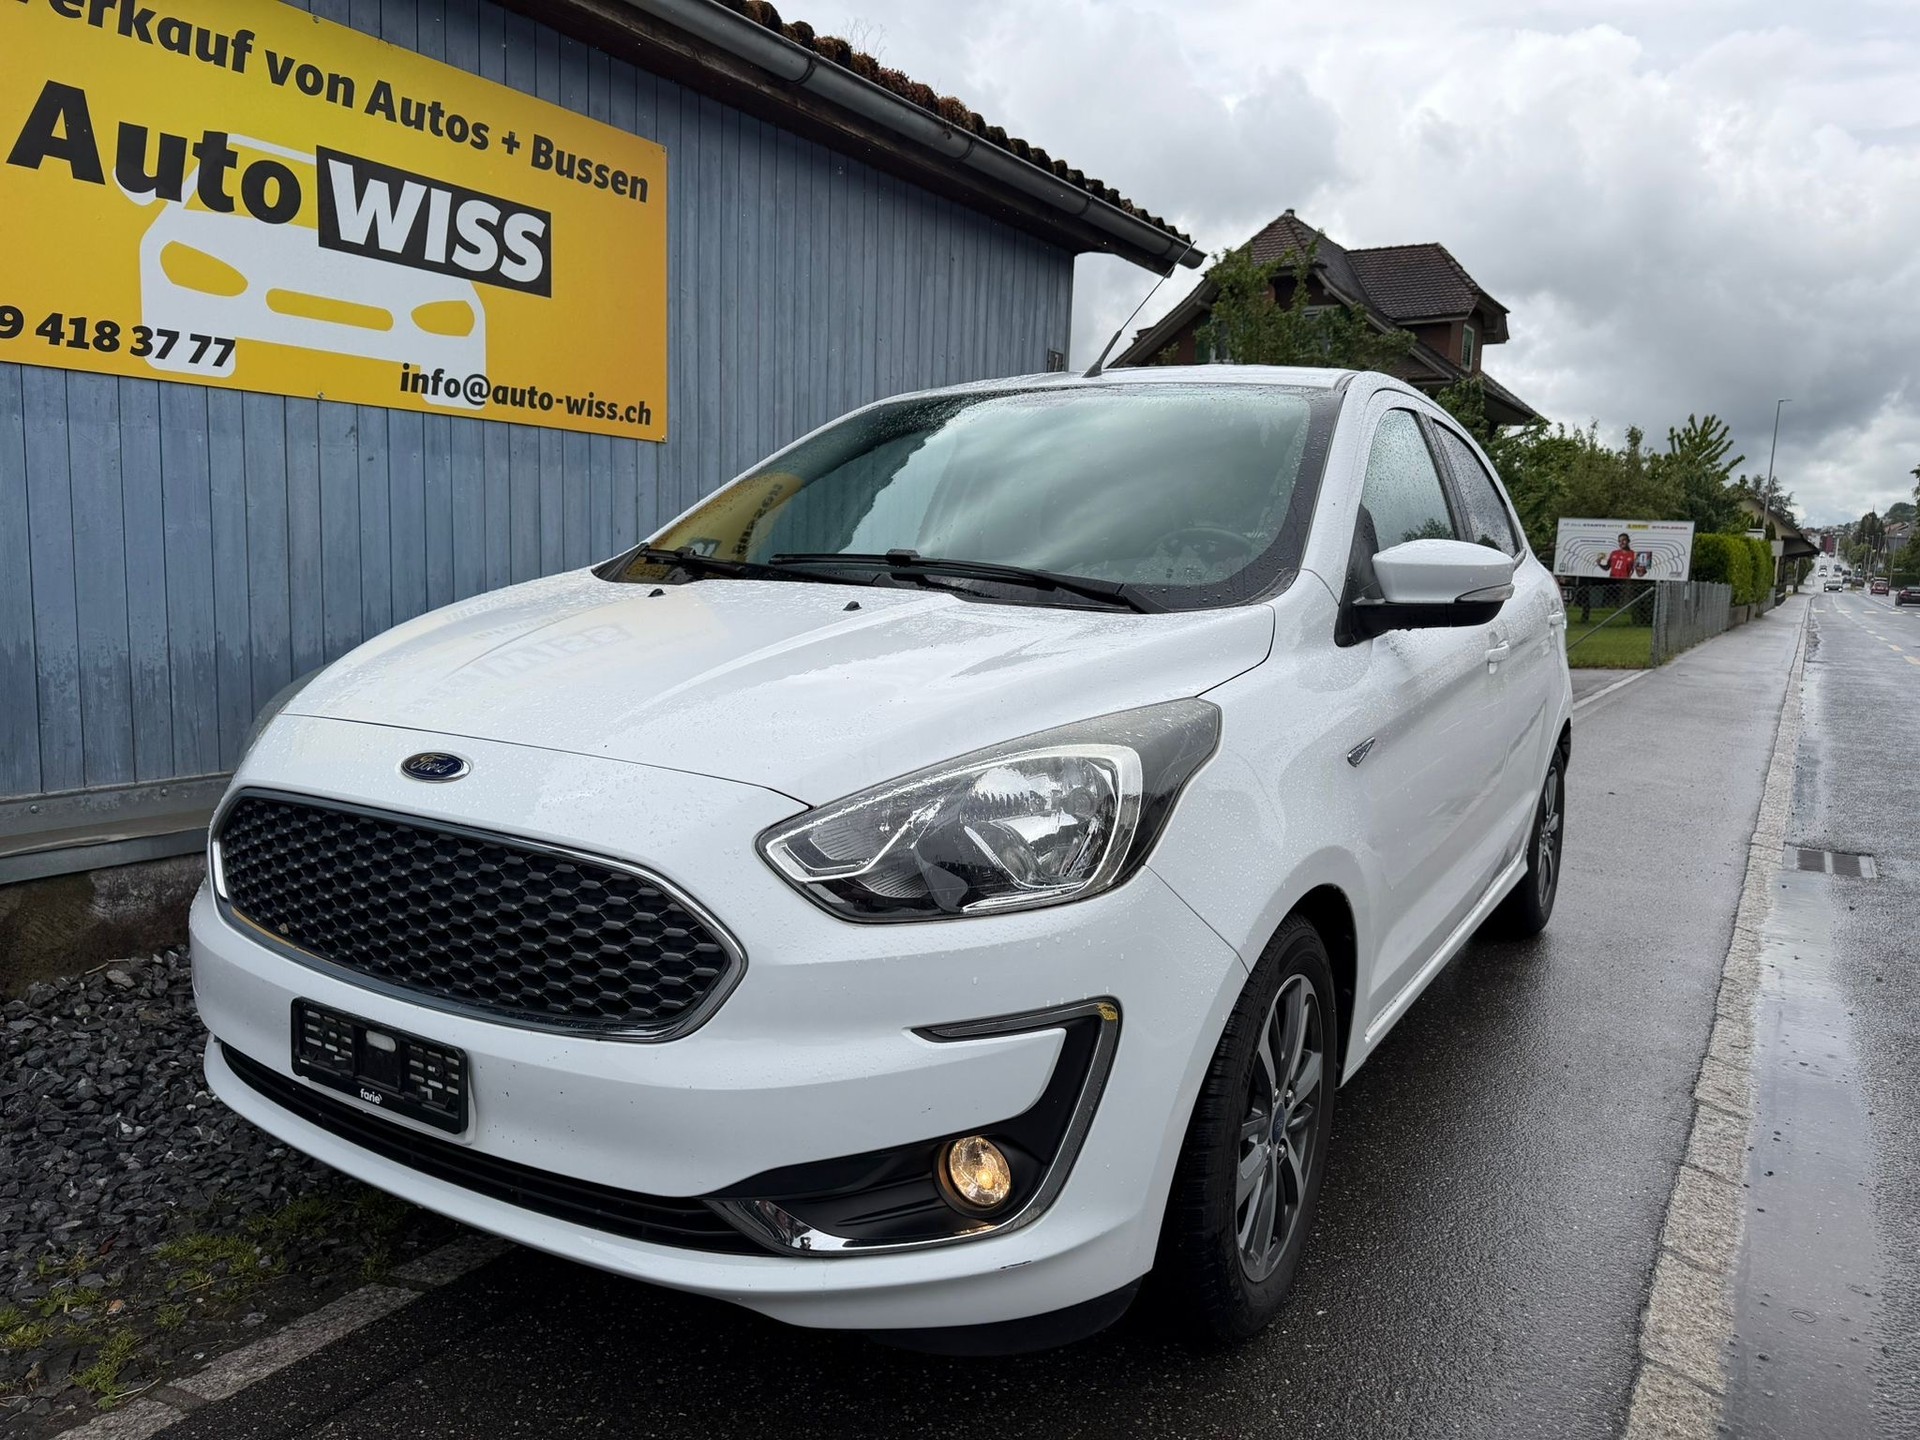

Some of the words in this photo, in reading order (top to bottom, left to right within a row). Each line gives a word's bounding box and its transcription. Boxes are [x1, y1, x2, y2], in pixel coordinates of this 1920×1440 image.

[16, 0, 255, 73] erkauf
[265, 50, 354, 108] von
[365, 80, 489, 150] Autos
[502, 131, 520, 155] +
[531, 134, 647, 202] Bussen
[6, 80, 301, 224] Auto
[328, 159, 545, 282] WISS
[36, 313, 120, 352] 418
[130, 326, 179, 359] 37
[189, 334, 235, 367] 77
[401, 363, 651, 425] info@auto-wiss.ch
[410, 755, 455, 774] Ford
